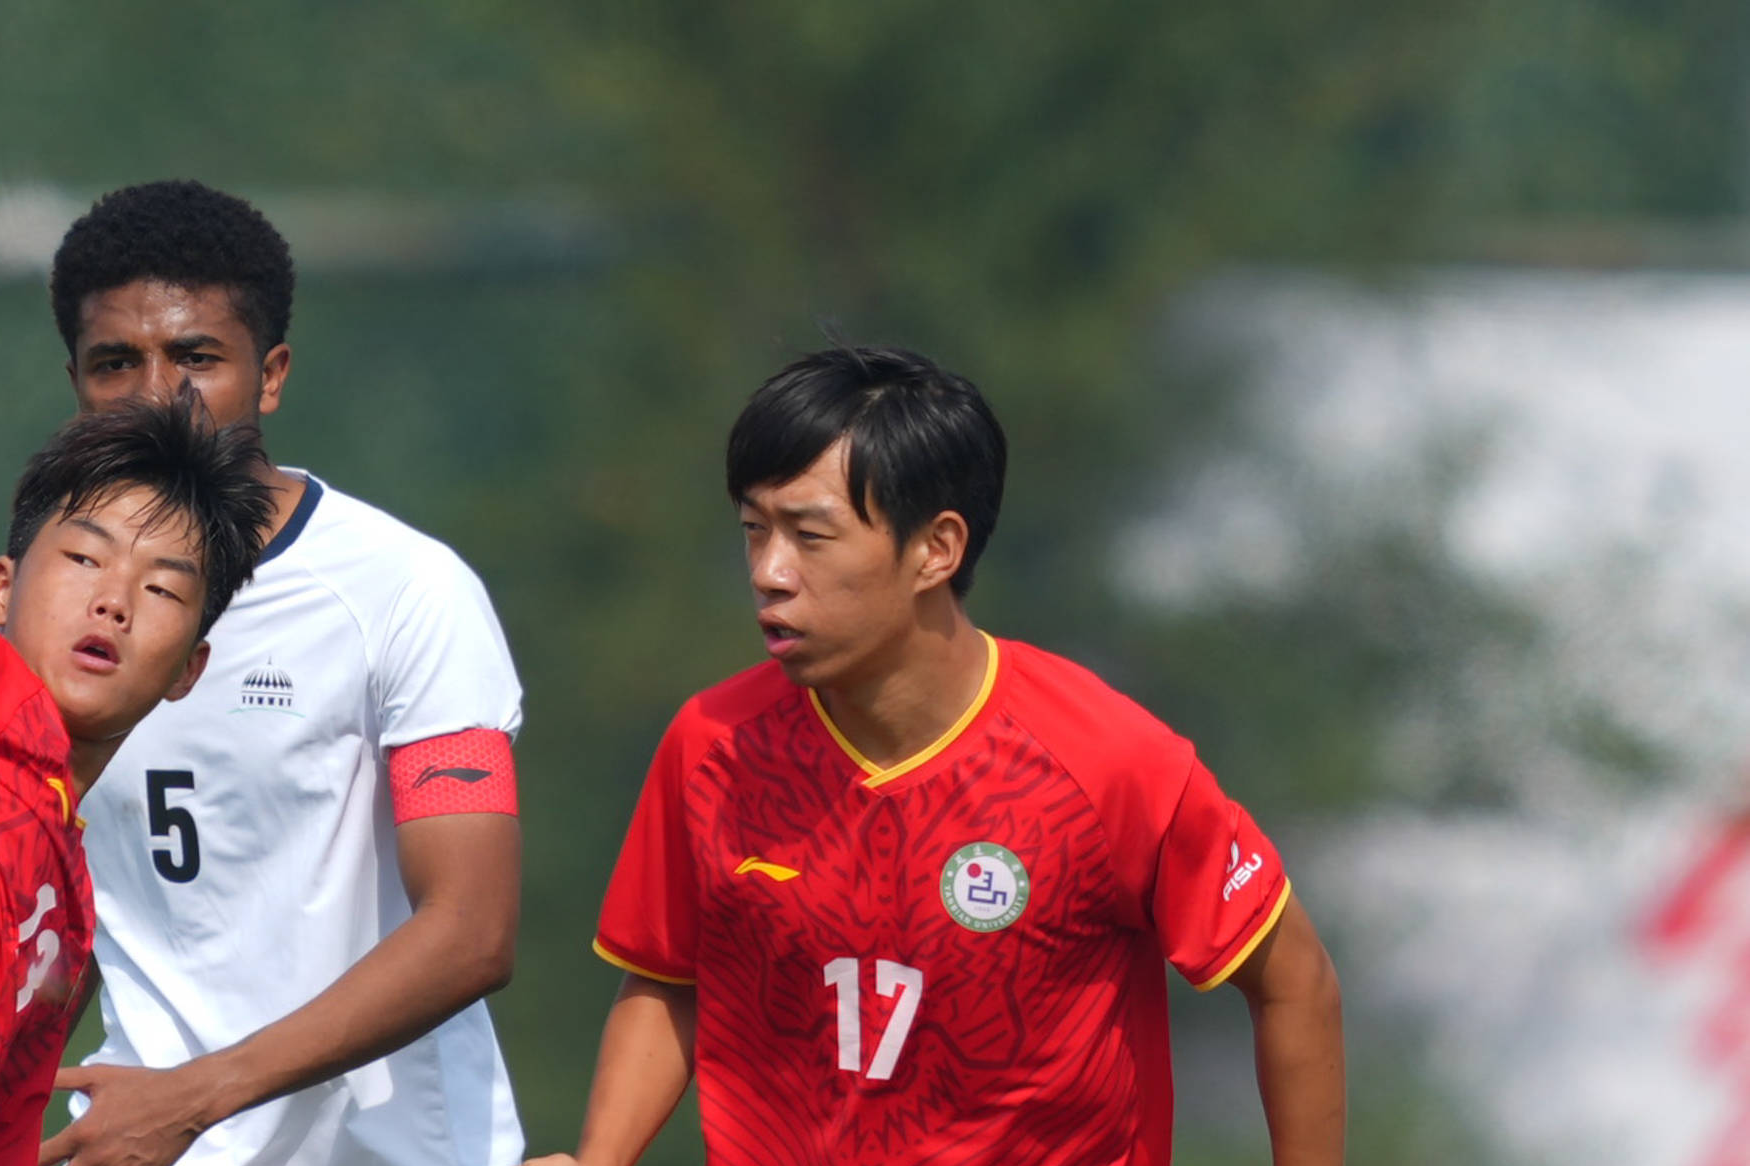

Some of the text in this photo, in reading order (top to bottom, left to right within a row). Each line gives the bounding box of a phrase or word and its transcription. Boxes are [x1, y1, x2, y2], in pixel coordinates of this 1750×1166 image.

[146, 769, 200, 883] 5
[1223, 852, 1263, 902] FISU
[823, 957, 923, 1081] 17
